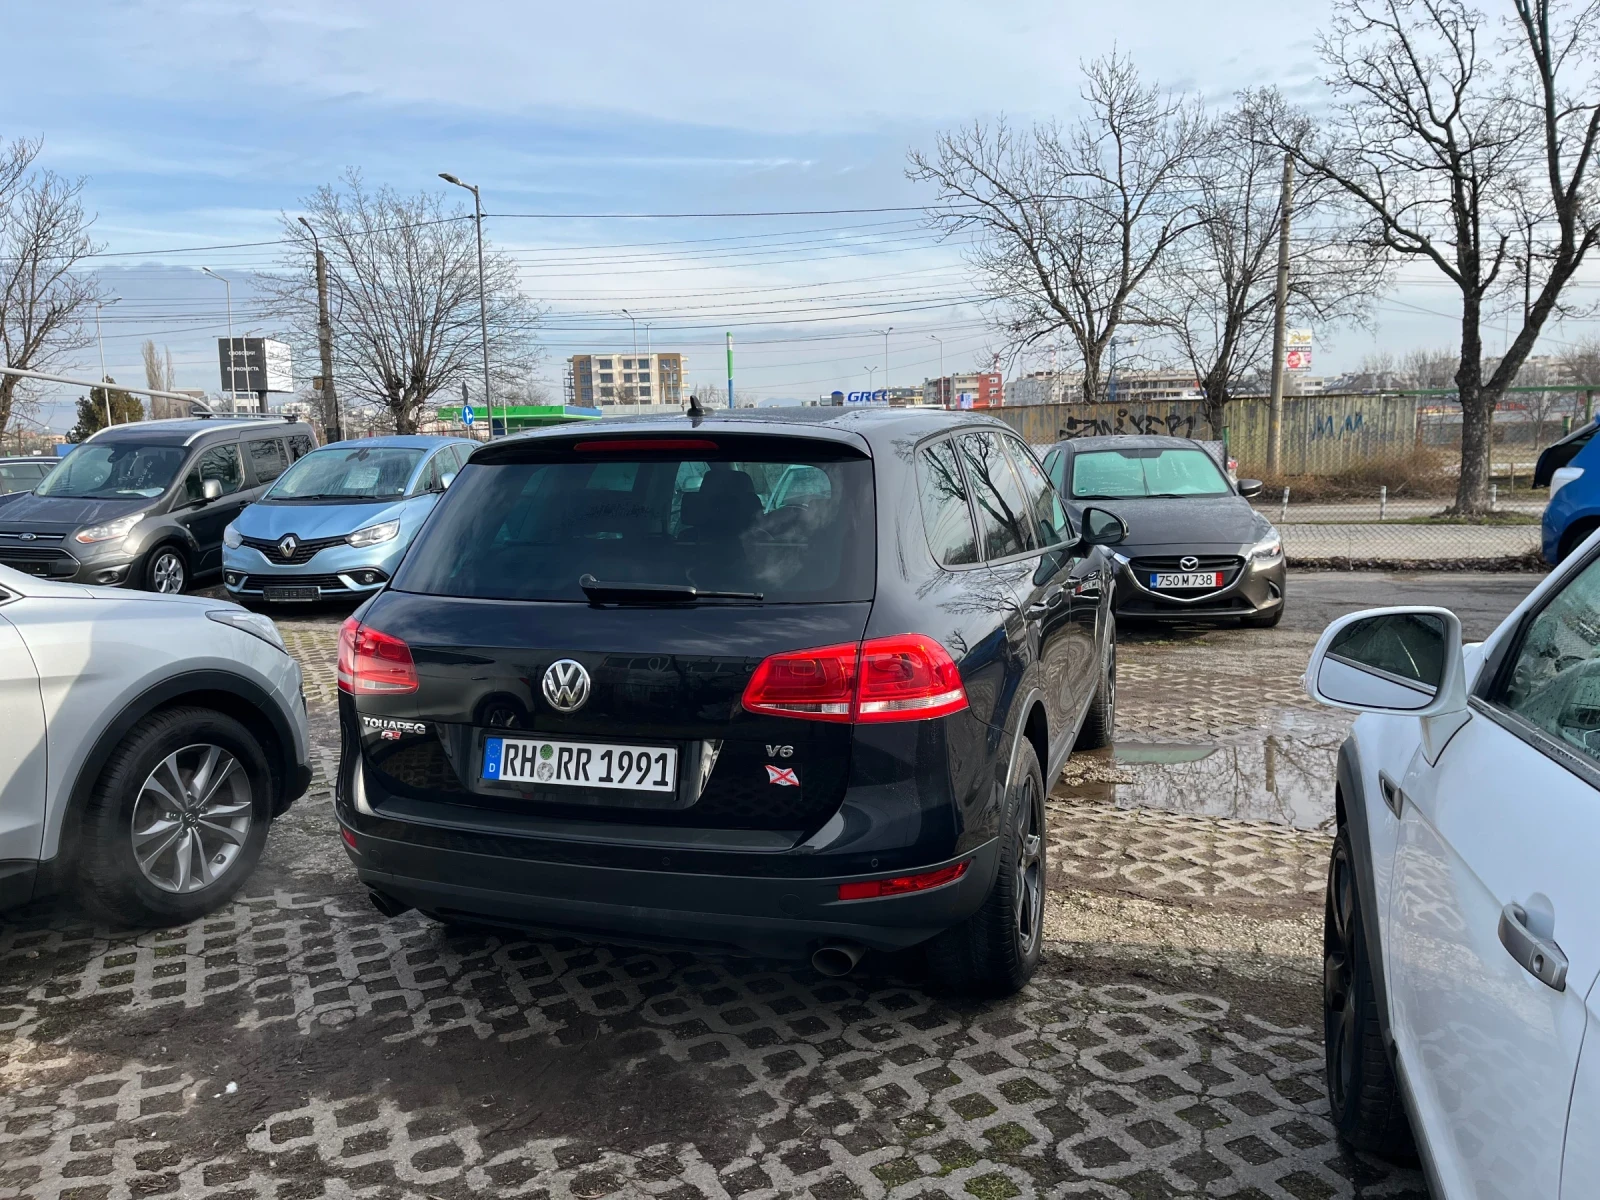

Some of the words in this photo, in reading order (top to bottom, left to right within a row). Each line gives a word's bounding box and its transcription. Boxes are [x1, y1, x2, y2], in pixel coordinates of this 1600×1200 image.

[363, 716, 426, 735] TOUAREG
[765, 744, 794, 758] V6
[488, 762, 496, 773] D
[502, 743, 537, 778] RH
[556, 747, 592, 781] RR
[598, 749, 669, 786] 1991
